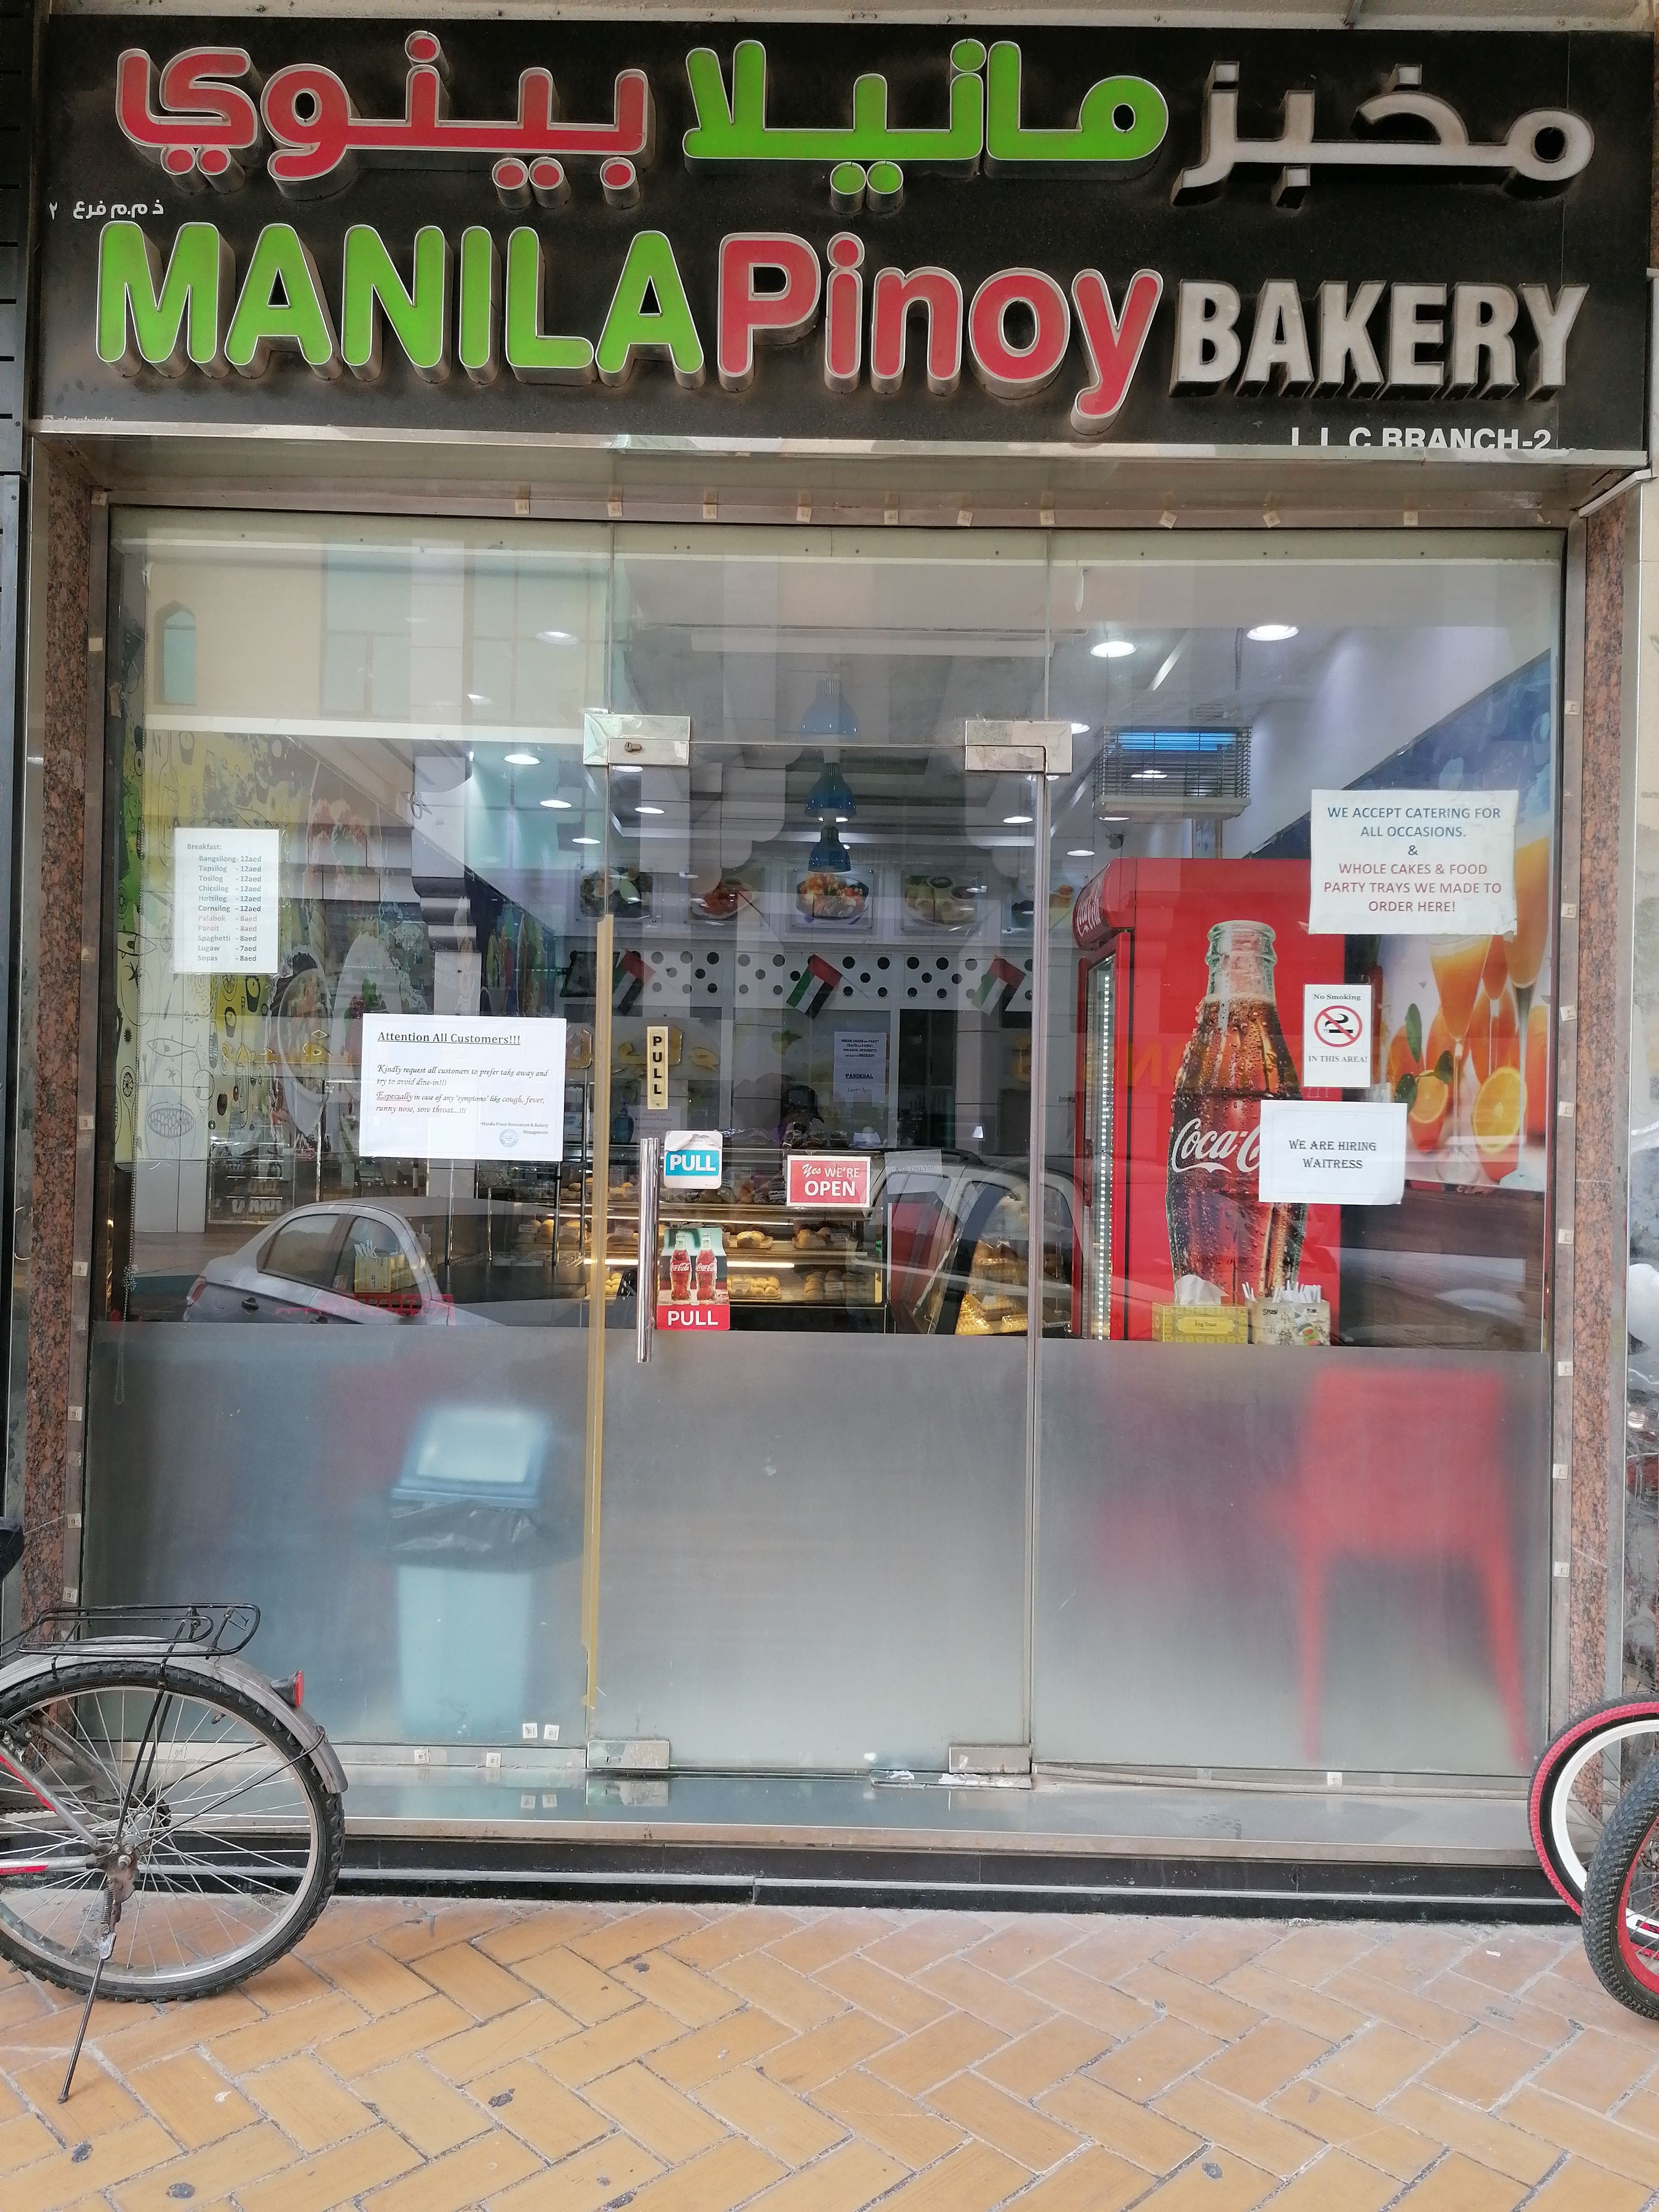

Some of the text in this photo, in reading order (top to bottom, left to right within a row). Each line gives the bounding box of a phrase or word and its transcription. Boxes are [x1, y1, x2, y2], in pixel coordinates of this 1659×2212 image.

[115, 30, 1594, 194] مخبز مانيلا بينوي
[73, 200, 106, 220] فرع
[96, 220, 1588, 420] MANILA Pinoy BAKERY
[1382, 427, 1552, 449] BRANCH-2
[1328, 807, 1500, 818] WE ACCEPT CATERING FOR
[1360, 827, 1465, 837] ALL OCCASIONS.
[1408, 845, 1418, 855] &
[1339, 864, 1487, 874] WHOLE CAKES & FOOD
[1324, 882, 1501, 893] PARTY TRAYS WE MADE TO
[1369, 901, 1455, 912] ORDER HERE!
[378, 1032, 521, 1044] Attention All Customers!!!
[377, 1065, 401, 1074] Kindly
[479, 1068, 500, 1077] prefer
[501, 1069, 514, 1077] take
[653, 1036, 663, 1094] PULL
[376, 1092, 412, 1101] Especially
[435, 1094, 443, 1102] of
[442, 1094, 454, 1103] any
[1171, 1118, 1260, 1173] Coca-C
[1289, 1139, 1377, 1151] WE ARE HIRING
[670, 1154, 716, 1172] PULL
[1303, 1158, 1362, 1169] WAITRESS
[802, 1164, 860, 1178] Yes WE'RE
[804, 1180, 856, 1197] OPEN
[668, 1310, 719, 1326] PULL
